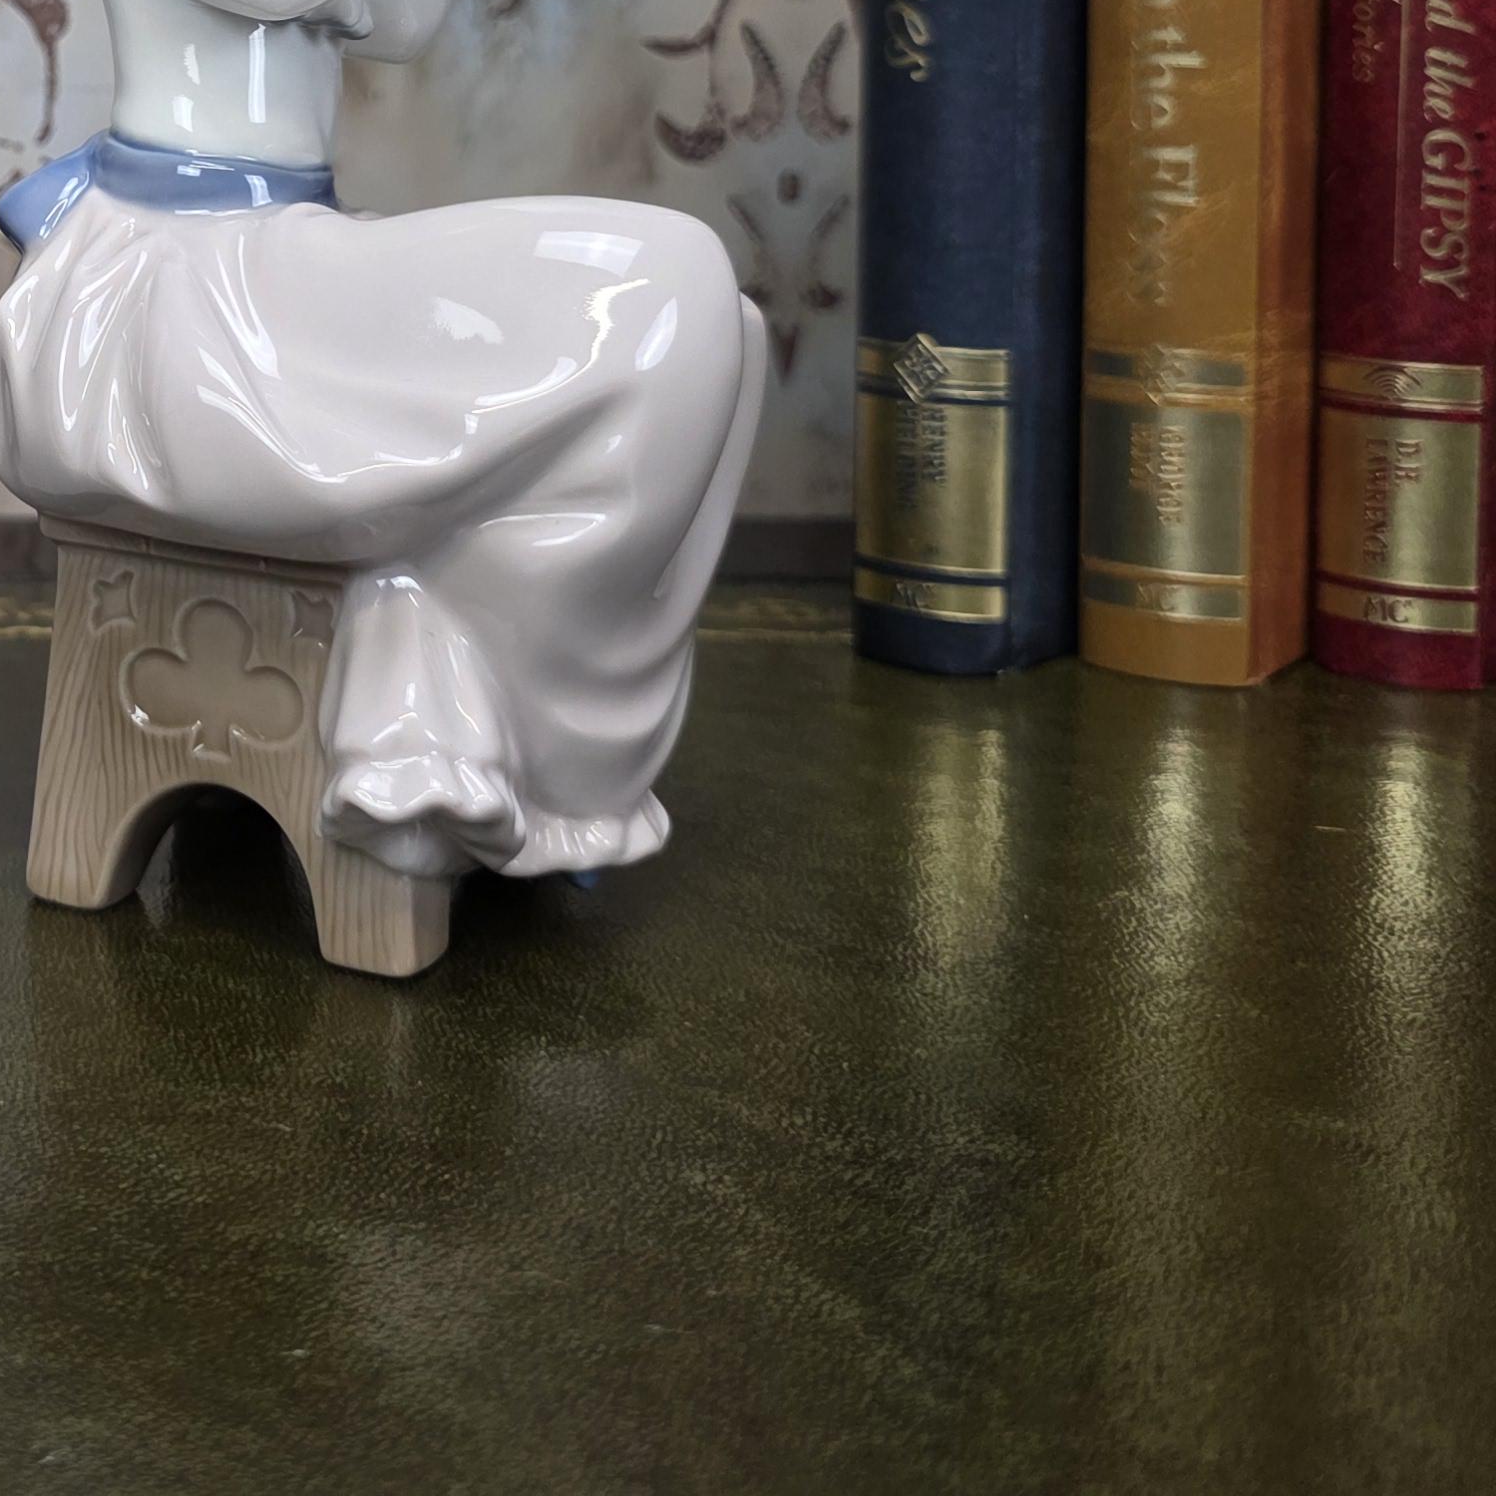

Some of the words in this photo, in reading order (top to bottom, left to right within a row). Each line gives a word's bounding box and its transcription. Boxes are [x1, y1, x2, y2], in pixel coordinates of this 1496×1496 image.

[1130, 26, 1206, 131] the
[1422, 46, 1476, 121] the
[1419, 130, 1472, 300] GIPSY
